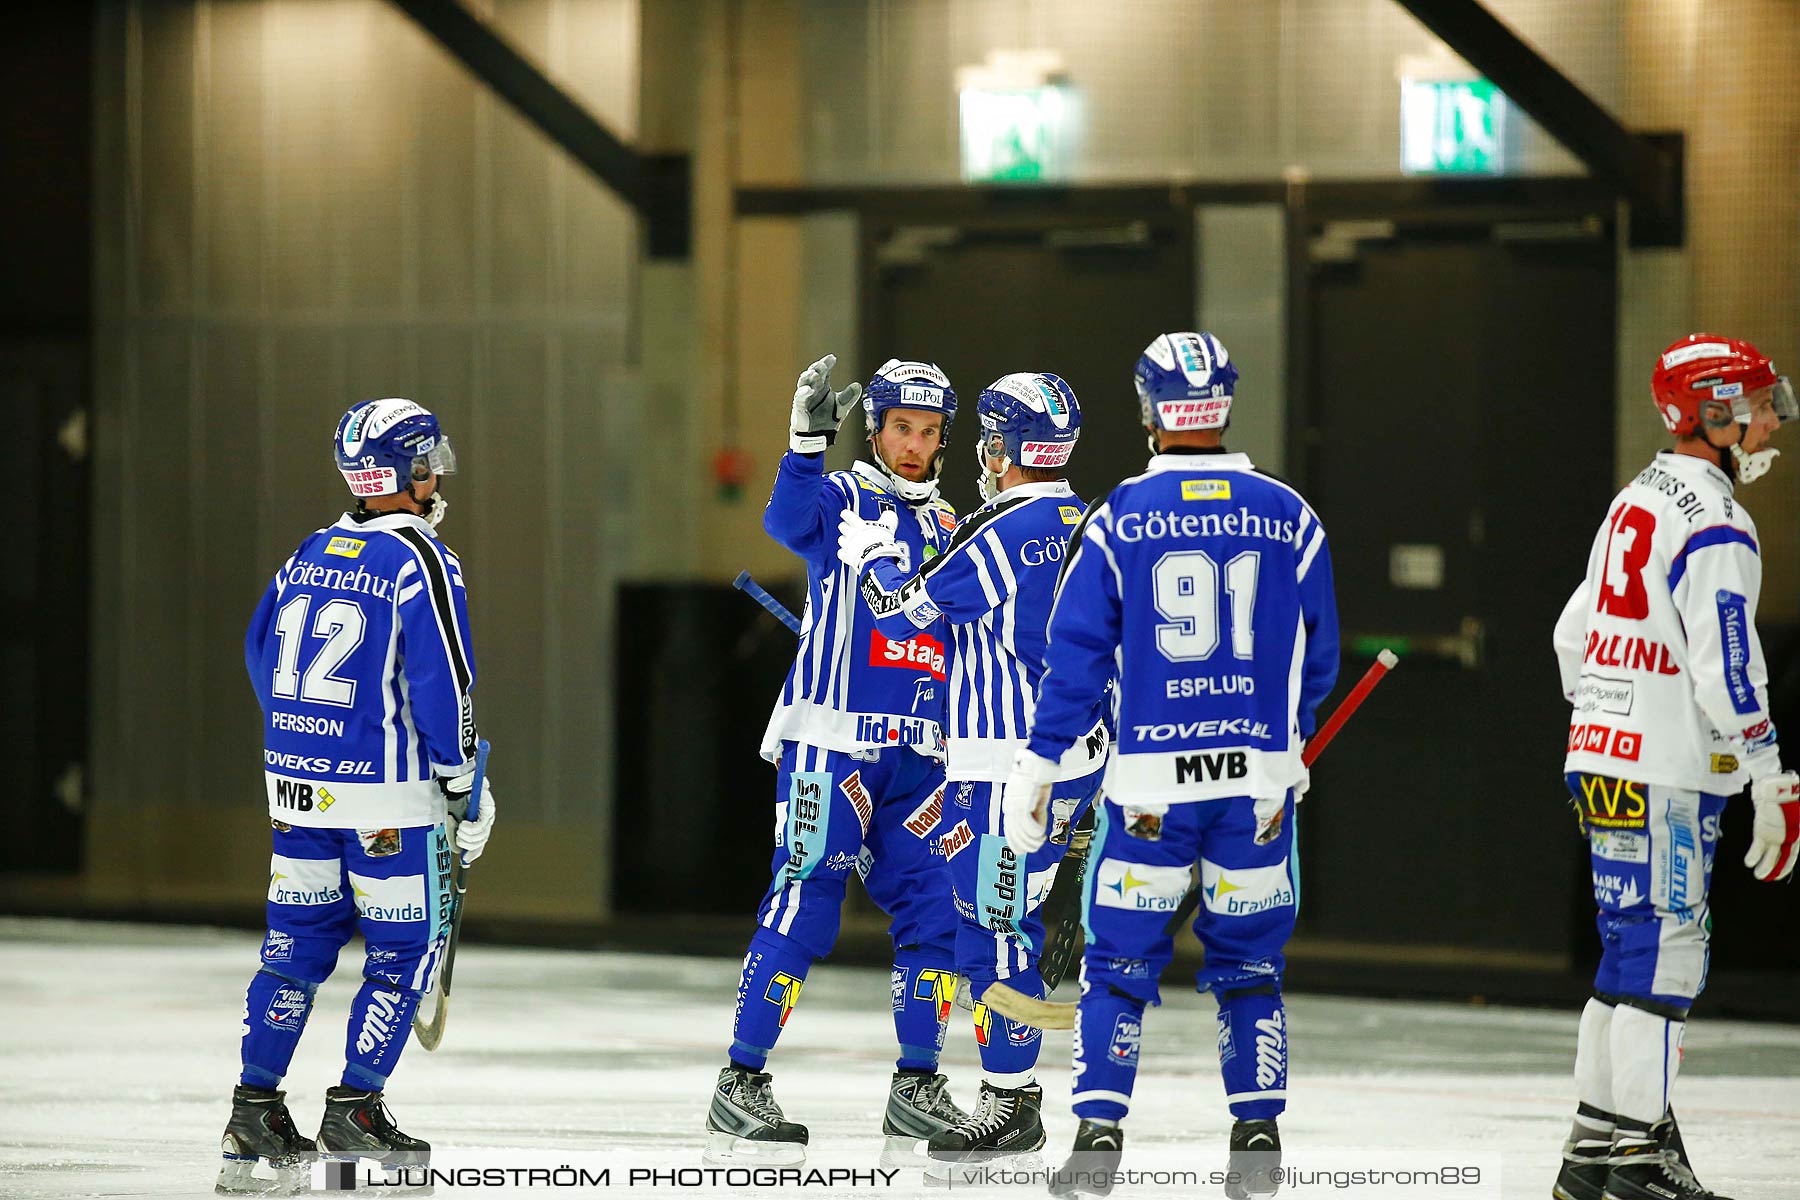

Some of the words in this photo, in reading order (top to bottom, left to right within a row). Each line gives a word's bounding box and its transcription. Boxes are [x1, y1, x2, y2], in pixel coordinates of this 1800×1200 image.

[1211, 383, 1225, 397] 91
[1175, 413, 1219, 427] BUSS
[360, 455, 377, 469] 12
[1676, 491, 1705, 523] BIL
[1116, 507, 1294, 543] Götenehus
[1597, 502, 1656, 620] 13
[288, 561, 395, 602] ötenehu
[1152, 550, 1262, 664] 91
[271, 593, 367, 709] 12
[271, 711, 345, 738] PERSSON
[264, 749, 331, 774] TOVEKS
[335, 760, 377, 776] BIL
[1175, 751, 1248, 784] MVB
[276, 778, 314, 812] MVB
[793, 778, 822, 837] SBL
[1580, 775, 1646, 818] YVS
[276, 886, 341, 904] bravida
[1227, 888, 1291, 914] bravida
[279, 990, 305, 1001] Villa
[356, 990, 402, 1055] Villa
[1255, 1009, 1282, 1090] Villa
